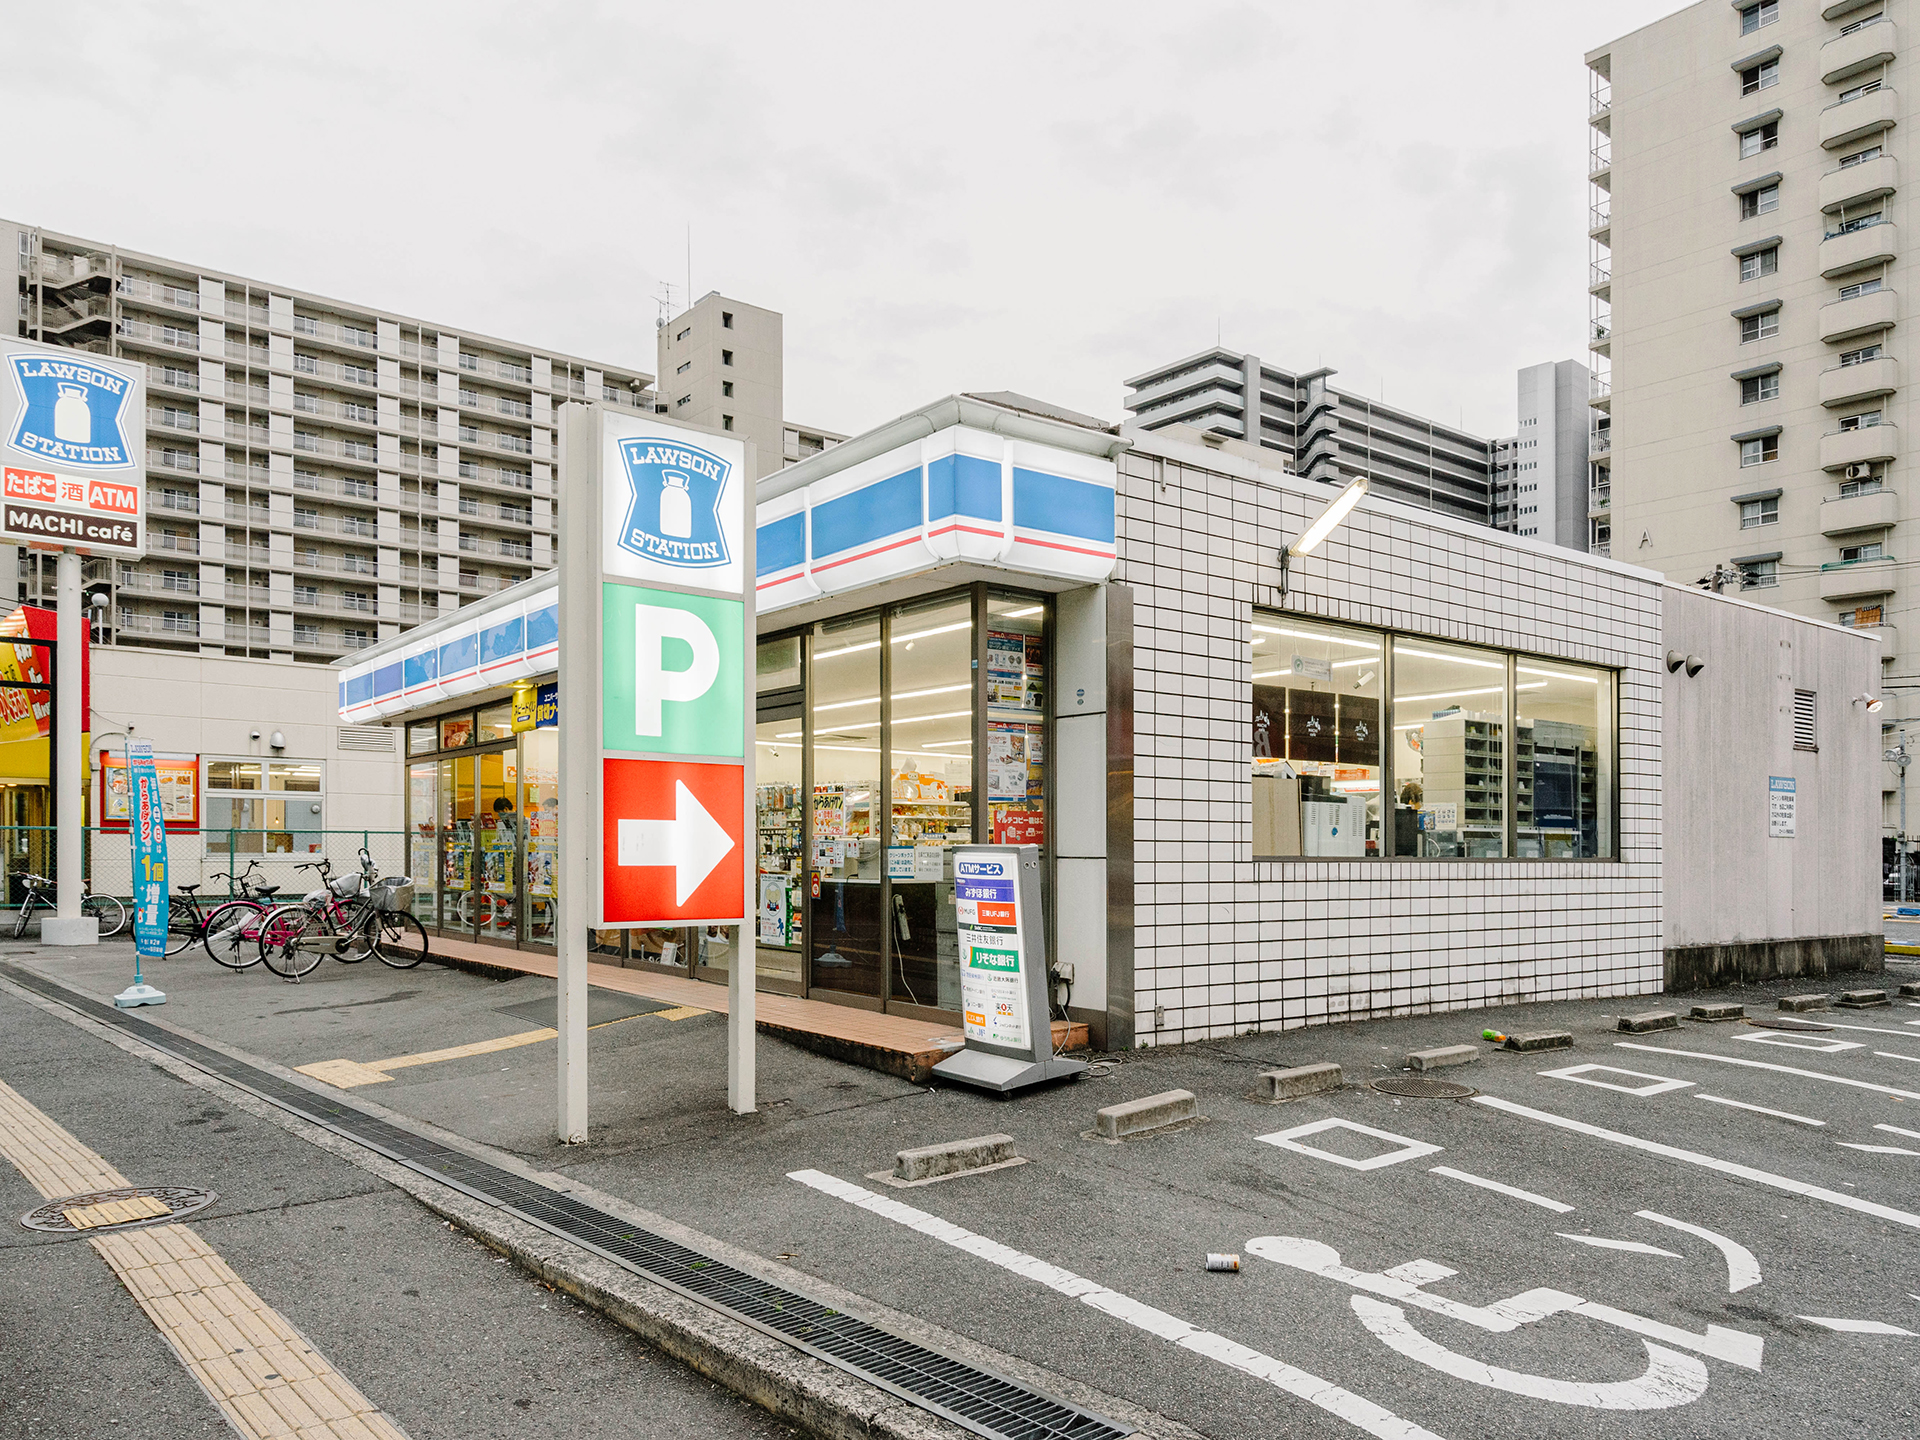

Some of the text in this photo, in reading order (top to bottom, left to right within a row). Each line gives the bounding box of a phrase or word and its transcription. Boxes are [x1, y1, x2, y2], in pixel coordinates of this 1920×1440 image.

[20, 362, 124, 395] LAWSON
[21, 431, 122, 462] STATION
[630, 447, 721, 481] LAWSON
[7, 472, 135, 510] たばこ 酒 ATM
[9, 510, 133, 542] MACHI café
[1639, 528, 1653, 549] A
[630, 528, 720, 560] STATION
[635, 603, 721, 737] P
[1771, 780, 1795, 790] LAWSON
[140, 777, 151, 842] からあげクン
[141, 855, 164, 882] 1個
[960, 863, 1001, 875] ATMサービス
[145, 884, 159, 926] 増量
[965, 887, 997, 900] みずほ銀行
[966, 933, 1004, 946] 三井住友銀行
[975, 951, 1015, 968] りそな銀行
